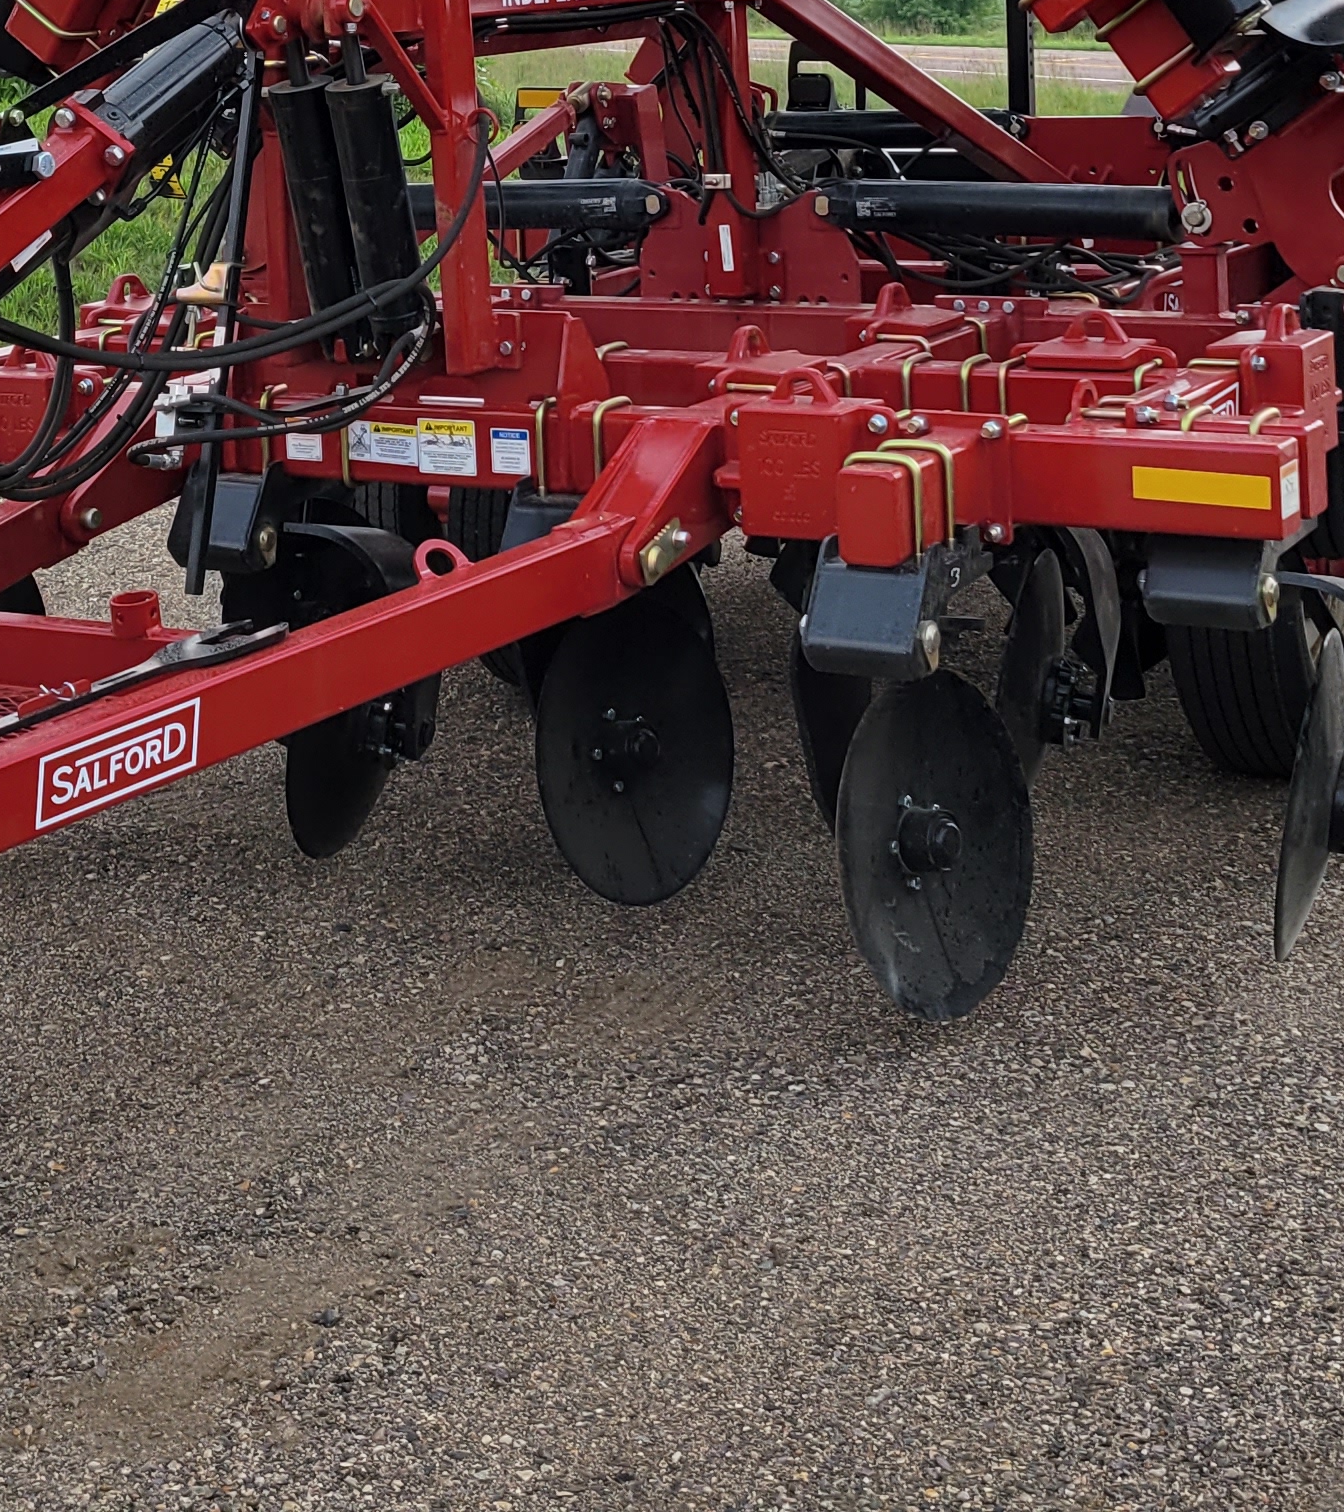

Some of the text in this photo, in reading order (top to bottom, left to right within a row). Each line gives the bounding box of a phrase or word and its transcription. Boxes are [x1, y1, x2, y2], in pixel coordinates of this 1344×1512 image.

[381, 425, 414, 435] IMPORTANT
[433, 423, 468, 433] IMPORTANT
[498, 431, 521, 439] NOTICE
[950, 567, 961, 588] 3
[50, 722, 187, 805] SALFORD
